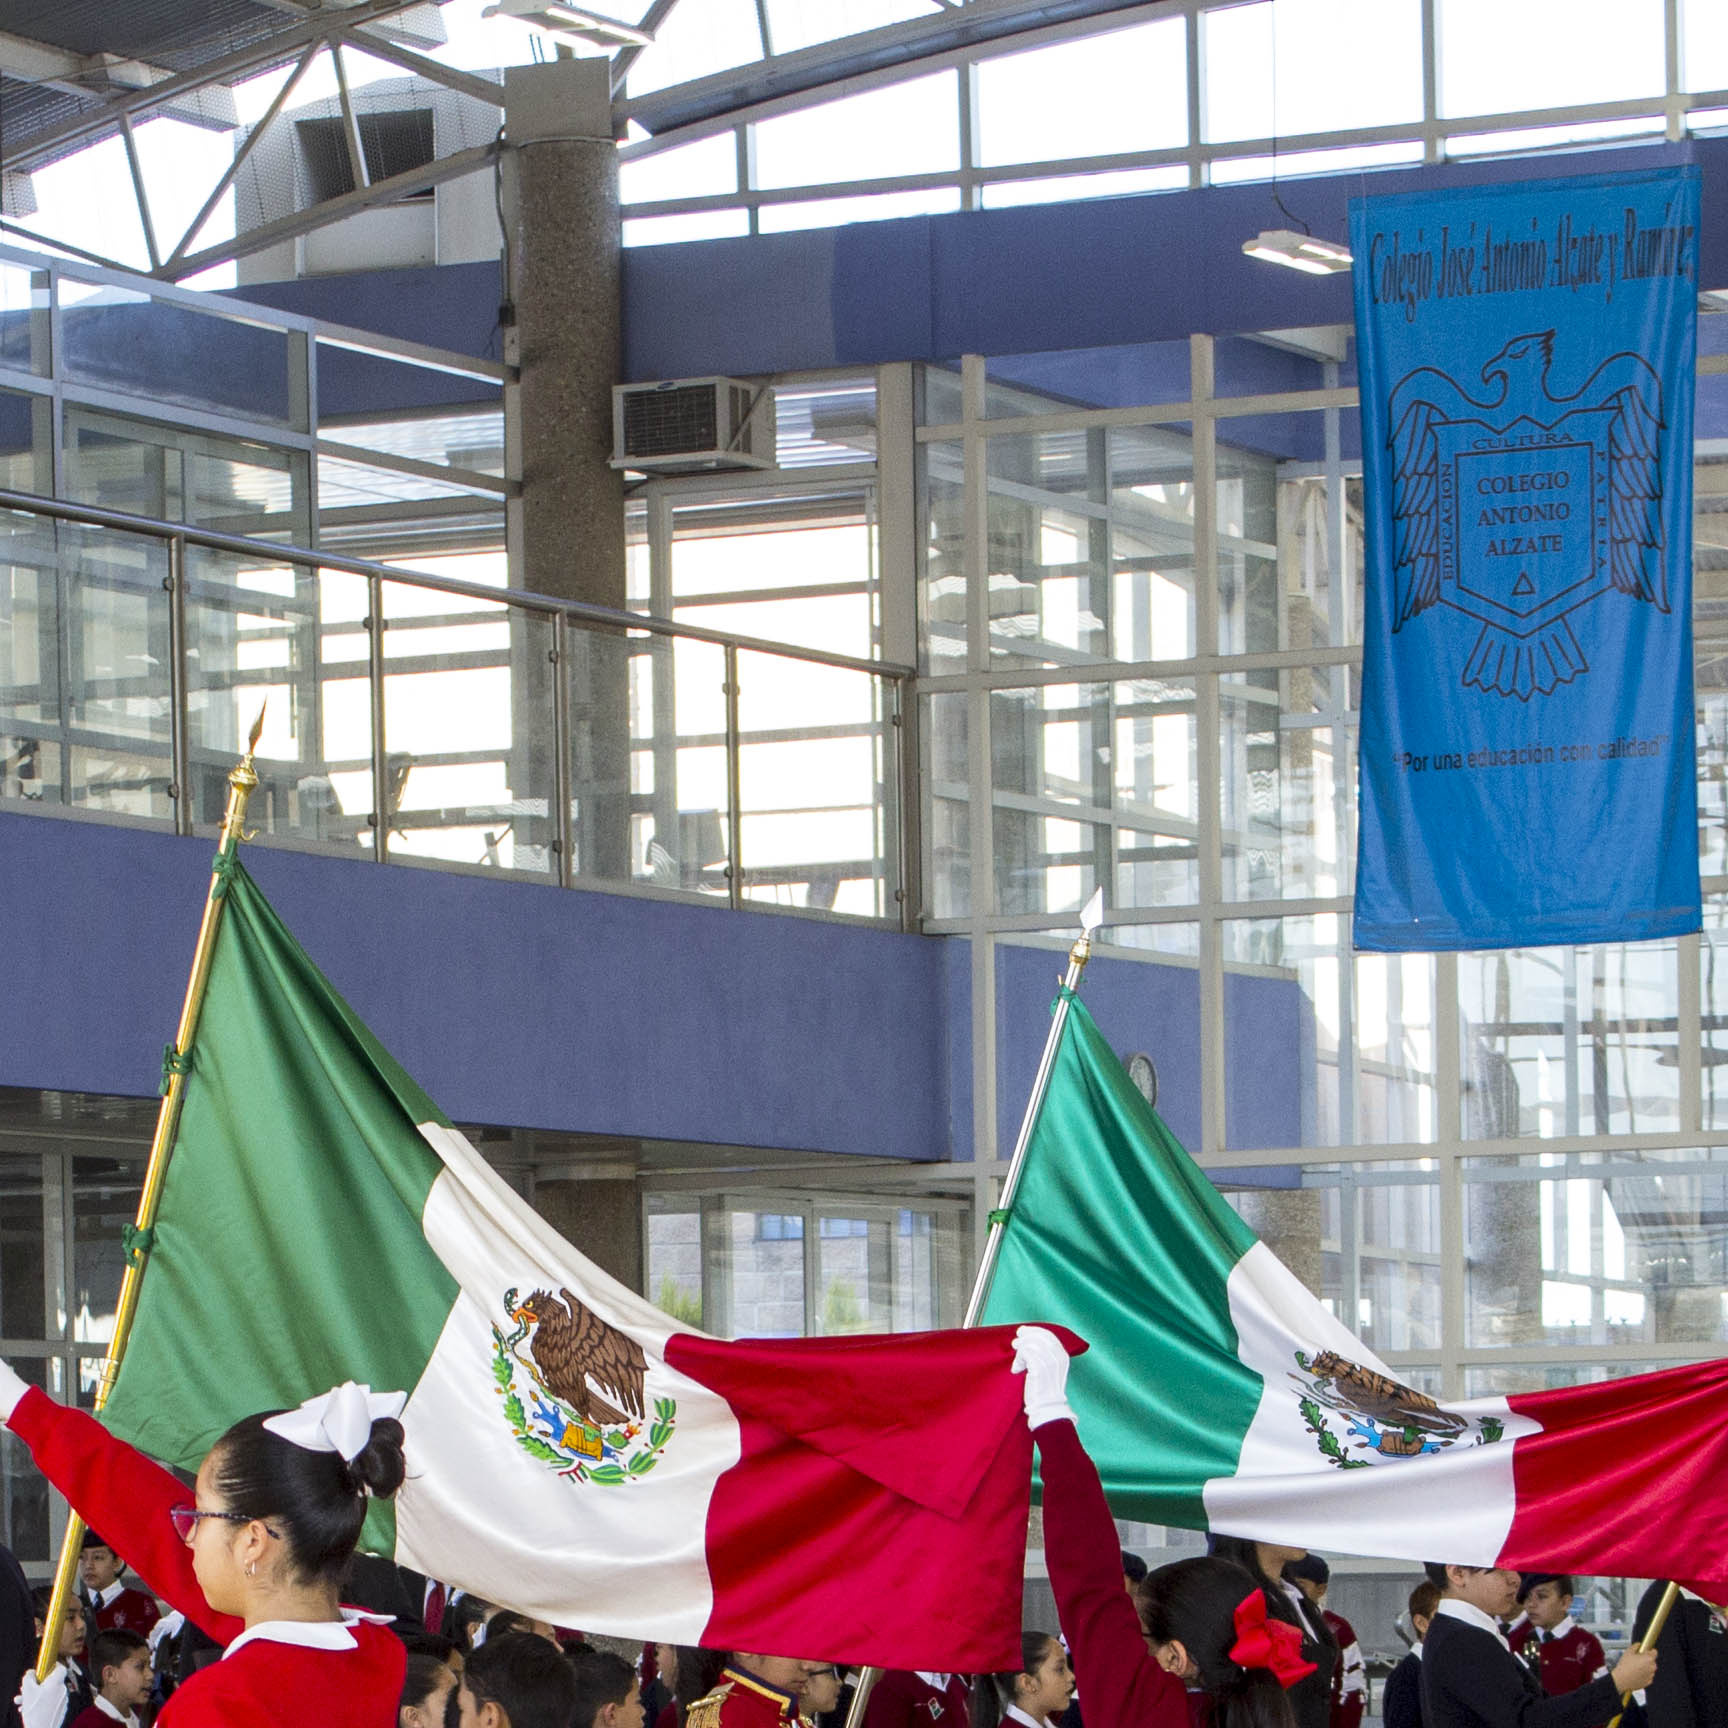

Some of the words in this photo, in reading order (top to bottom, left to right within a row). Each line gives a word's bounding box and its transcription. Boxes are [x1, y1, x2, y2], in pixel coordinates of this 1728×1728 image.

[1370, 229, 1433, 323] Colegio
[1437, 222, 1476, 299] José
[1477, 216, 1547, 294] Antonio
[1550, 213, 1604, 293] Alzate
[1605, 232, 1618, 304] y
[1473, 432, 1575, 449] CULTURA
[1477, 471, 1570, 495] COLEGIO
[1440, 463, 1454, 580] EDUCACION
[1477, 503, 1570, 527] ANTONIO
[1485, 535, 1563, 557] ALZATE
[1433, 752, 1463, 770] una
[1467, 741, 1554, 768] educación
[1559, 743, 1593, 761] con
